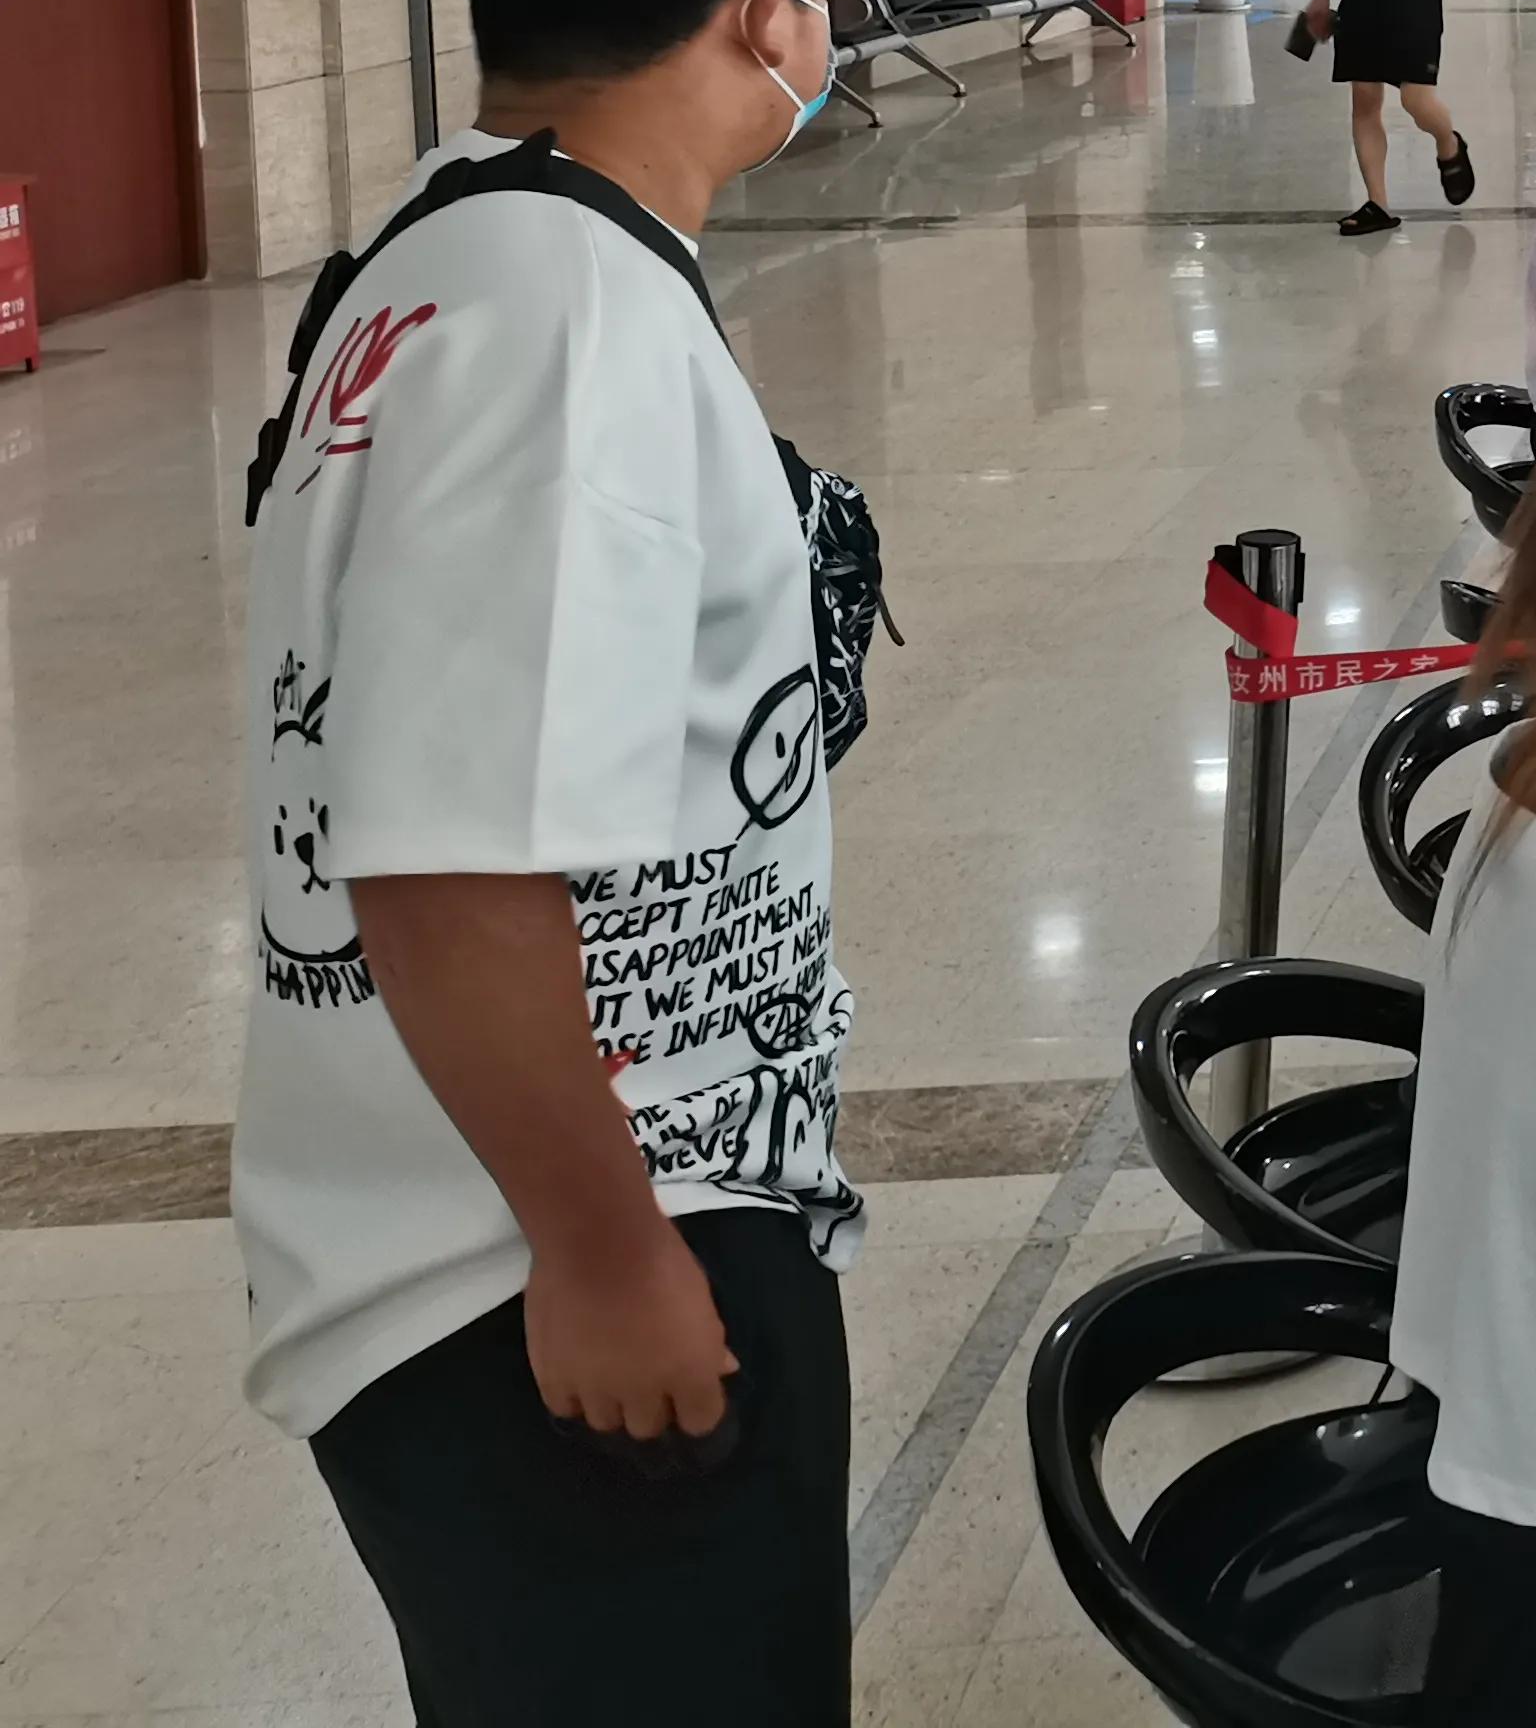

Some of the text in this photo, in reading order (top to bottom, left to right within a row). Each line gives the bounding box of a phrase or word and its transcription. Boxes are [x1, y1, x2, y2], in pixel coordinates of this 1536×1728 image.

[579, 861, 780, 945] CCEPT FINITE
[631, 843, 738, 898] MUST
[585, 881, 822, 989] ISAPPOINTMENT,
[591, 909, 831, 1030] UT WE MUST NEVE
[265, 949, 375, 1009] HAPPIN
